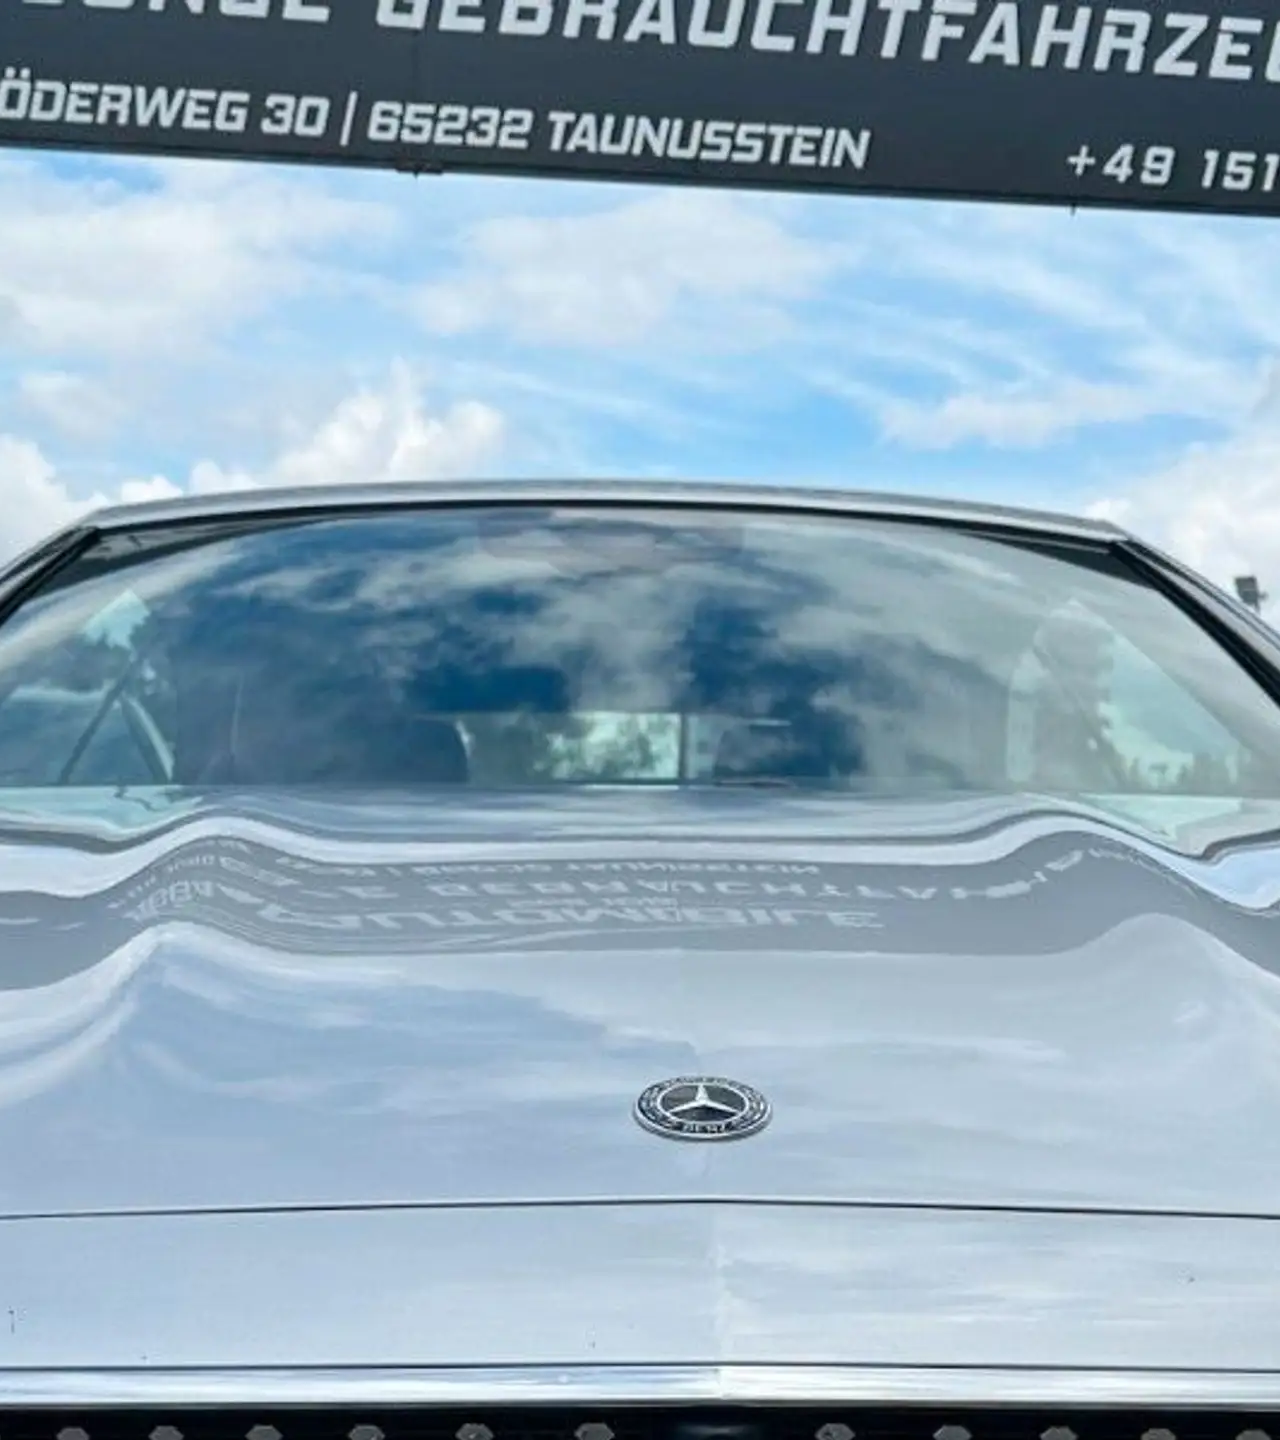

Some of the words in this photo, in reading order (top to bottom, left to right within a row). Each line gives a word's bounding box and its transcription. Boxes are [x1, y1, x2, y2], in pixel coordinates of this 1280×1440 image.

[260, 93, 331, 138] 30
[366, 100, 535, 150] 65232
[547, 111, 872, 170] TAUNUSSTEIN
[1067, 143, 1176, 186] +49
[1201, 149, 1280, 192] 151
